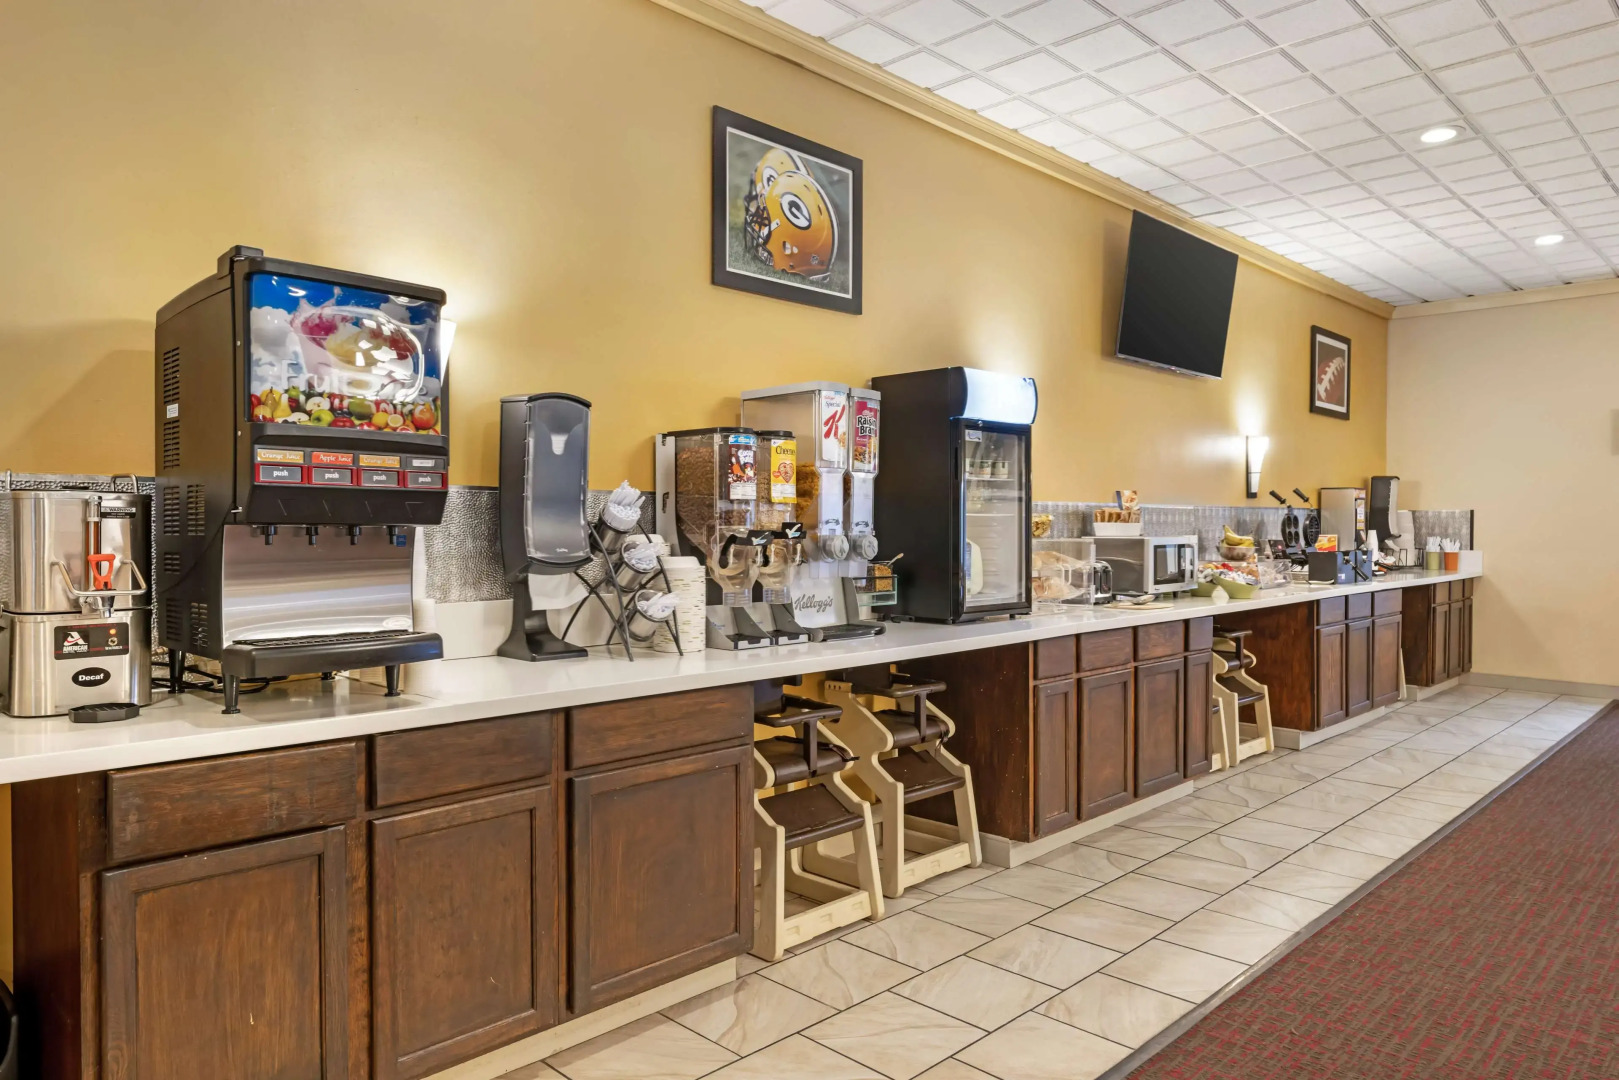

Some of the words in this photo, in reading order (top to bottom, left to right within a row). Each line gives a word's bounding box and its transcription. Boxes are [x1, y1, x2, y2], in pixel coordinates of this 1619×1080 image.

[823, 404, 846, 439] K
[319, 454, 337, 463] Apple
[337, 454, 352, 462] Juice
[273, 469, 289, 477] push
[324, 471, 340, 480] push
[372, 473, 387, 482] push
[418, 475, 432, 483] push
[794, 594, 833, 612] Kellogg's
[78, 673, 105, 682] Decaf
